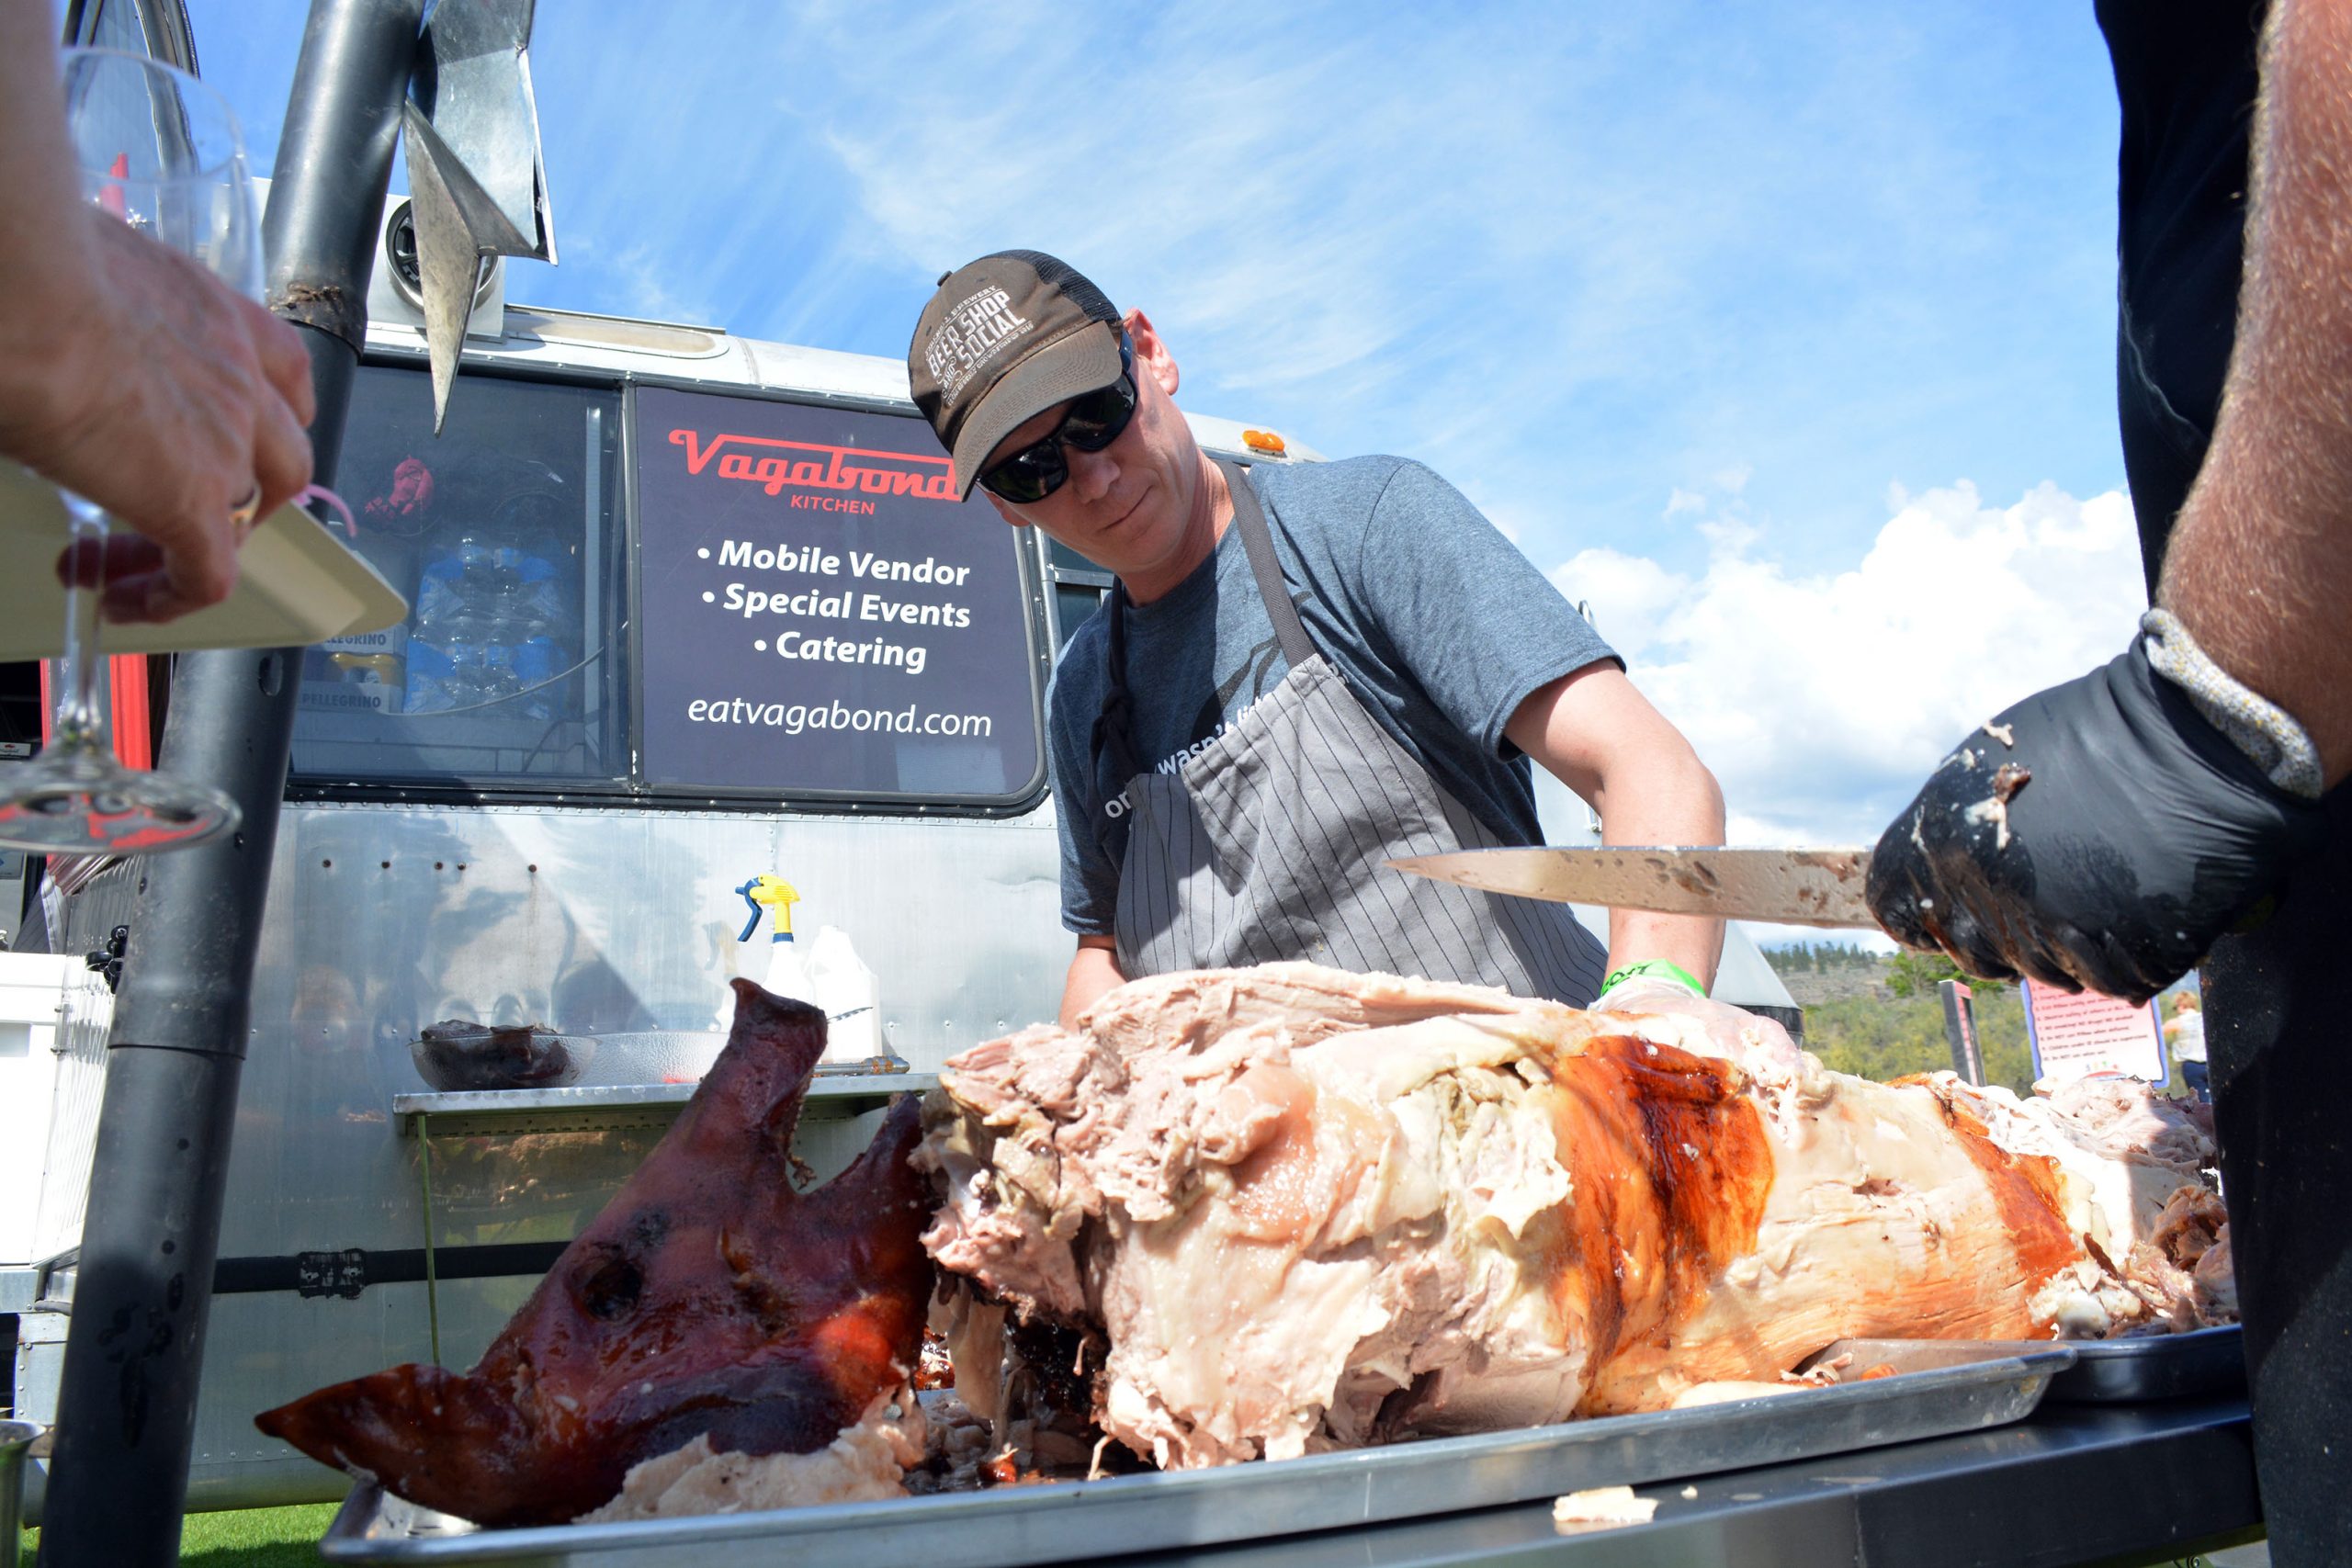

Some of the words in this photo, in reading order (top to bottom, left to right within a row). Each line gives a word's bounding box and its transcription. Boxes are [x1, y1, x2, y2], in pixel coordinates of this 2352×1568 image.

[928, 325, 963, 378] BEER
[957, 290, 1010, 336] SHOP
[956, 308, 1026, 369] SOCIAL
[668, 429, 962, 502] Vagabond
[790, 494, 875, 515] KITCHEN
[718, 540, 841, 576] Mobile
[849, 551, 970, 586] Vendor
[723, 583, 853, 618] Special
[860, 594, 971, 628] Events
[776, 631, 927, 674] Catering
[687, 697, 992, 737] eatvagabond.com
